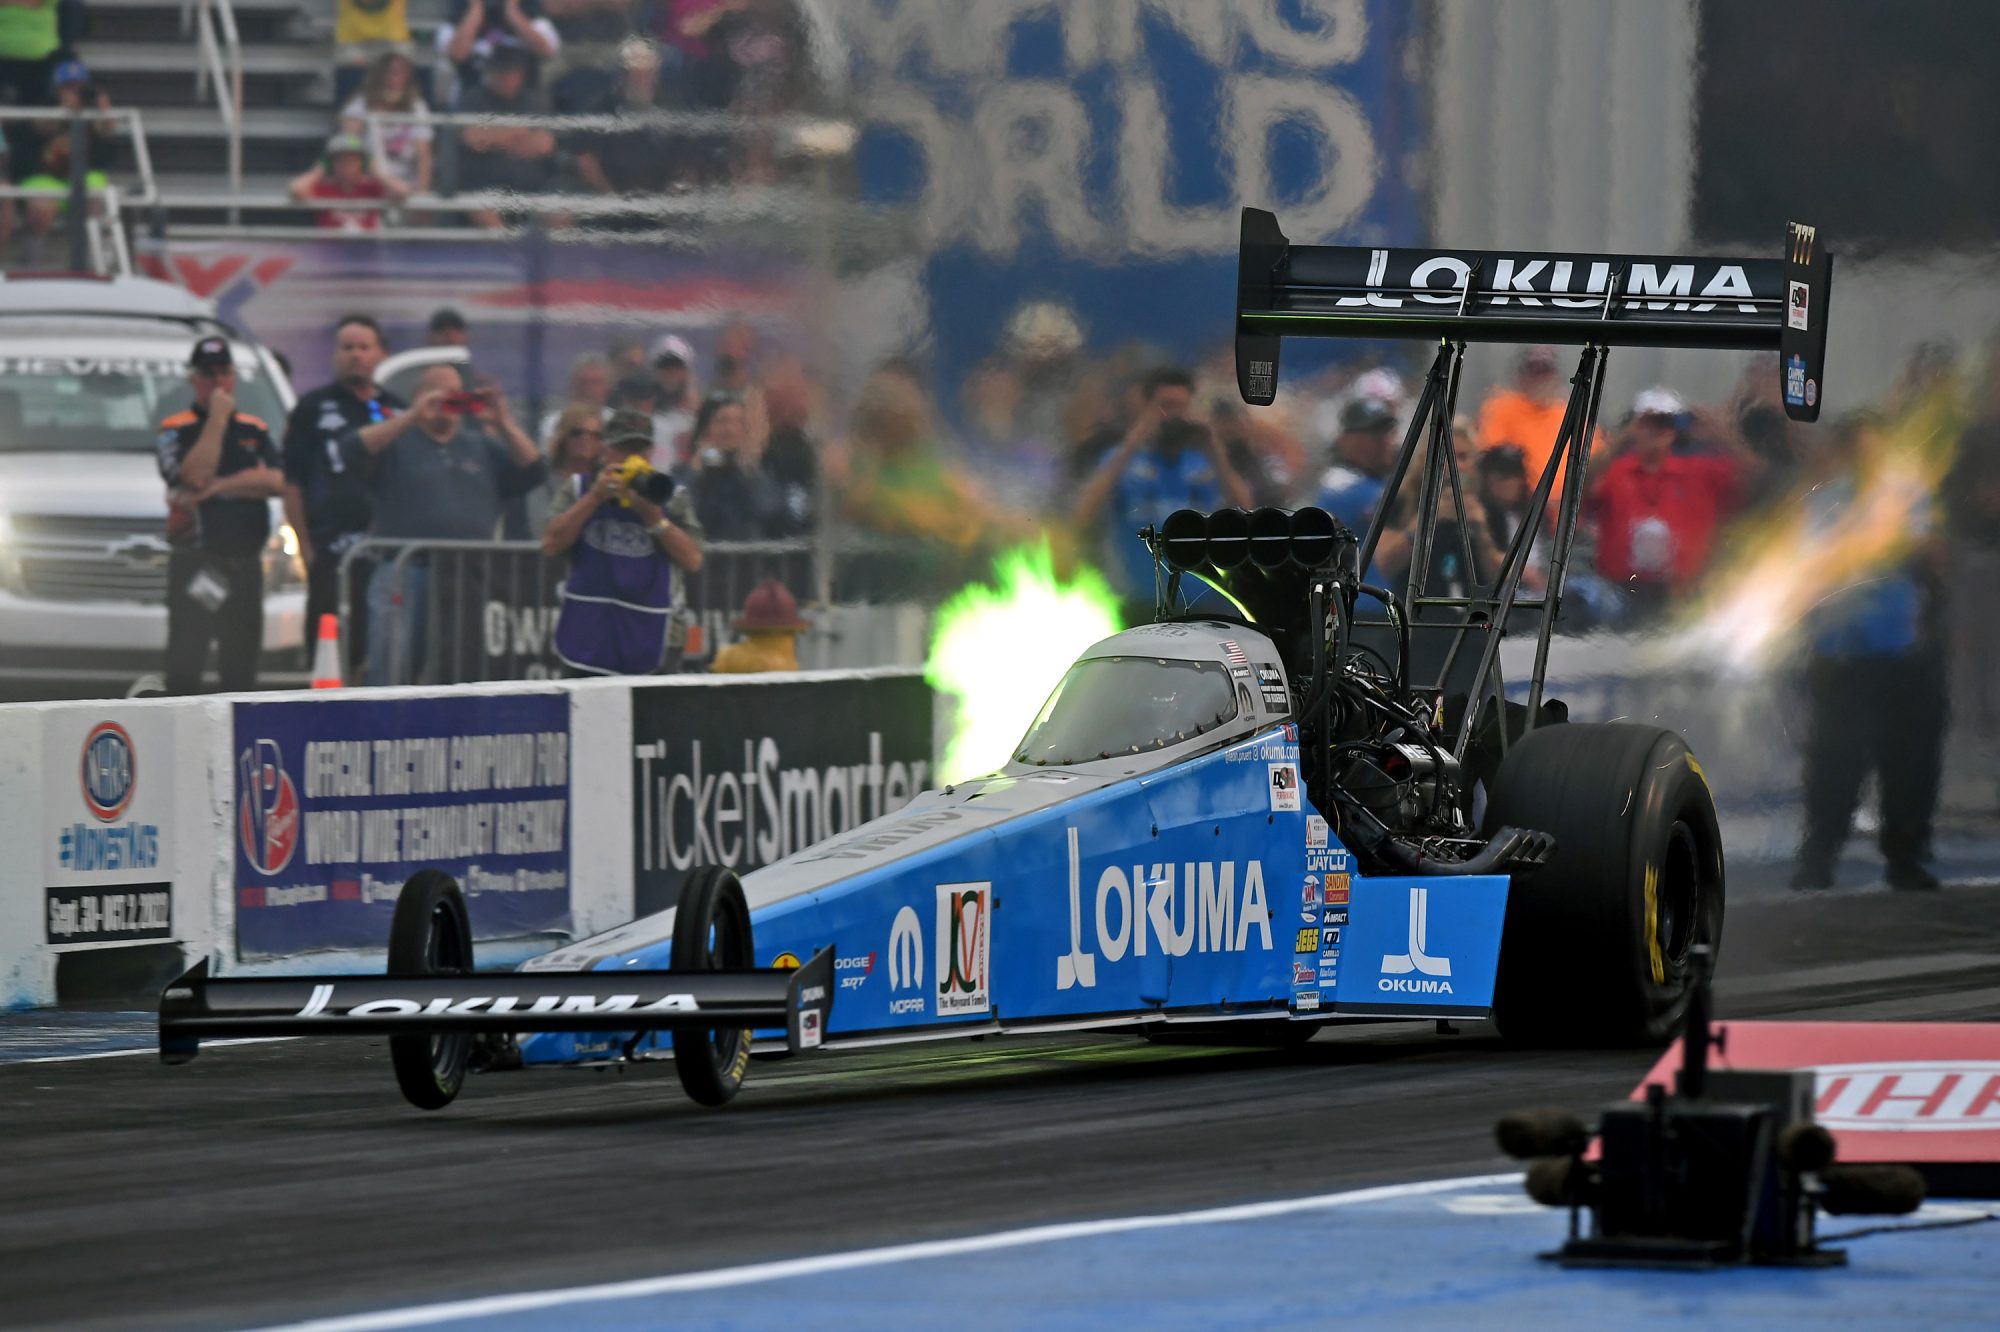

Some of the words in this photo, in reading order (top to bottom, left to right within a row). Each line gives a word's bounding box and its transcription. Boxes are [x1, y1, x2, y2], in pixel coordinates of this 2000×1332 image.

[1793, 223, 1816, 266] 777
[1410, 257, 1758, 313] OKUMA
[1260, 669, 1281, 681] OKUMA
[1260, 742, 1299, 760] okuma.com
[1401, 743, 1451, 761] HEI
[305, 741, 371, 798] OFFICIAL
[374, 737, 449, 796] TRACTION
[451, 733, 536, 793] COMPOUND
[536, 731, 568, 787] FOR
[635, 732, 928, 871] TicketSmarter
[304, 811, 360, 865] WORLD
[361, 809, 402, 863] WIDE
[402, 803, 495, 862] TECHNOLOGY
[494, 799, 567, 856] RACEWAY
[1306, 848, 1350, 871] DAYCO
[1325, 874, 1349, 890] SANDVIK
[1095, 860, 1273, 963] OKUMA
[1330, 913, 1347, 923] IMPACT
[1296, 928, 1319, 952] JEGS
[834, 957, 869, 969] ODGE
[840, 976, 866, 990] SRT
[1378, 978, 1454, 994] OKUMA
[889, 998, 925, 1015] MOPAR
[939, 998, 949, 1008] The
[951, 996, 970, 1010] Maynard
[971, 994, 987, 1008] Family
